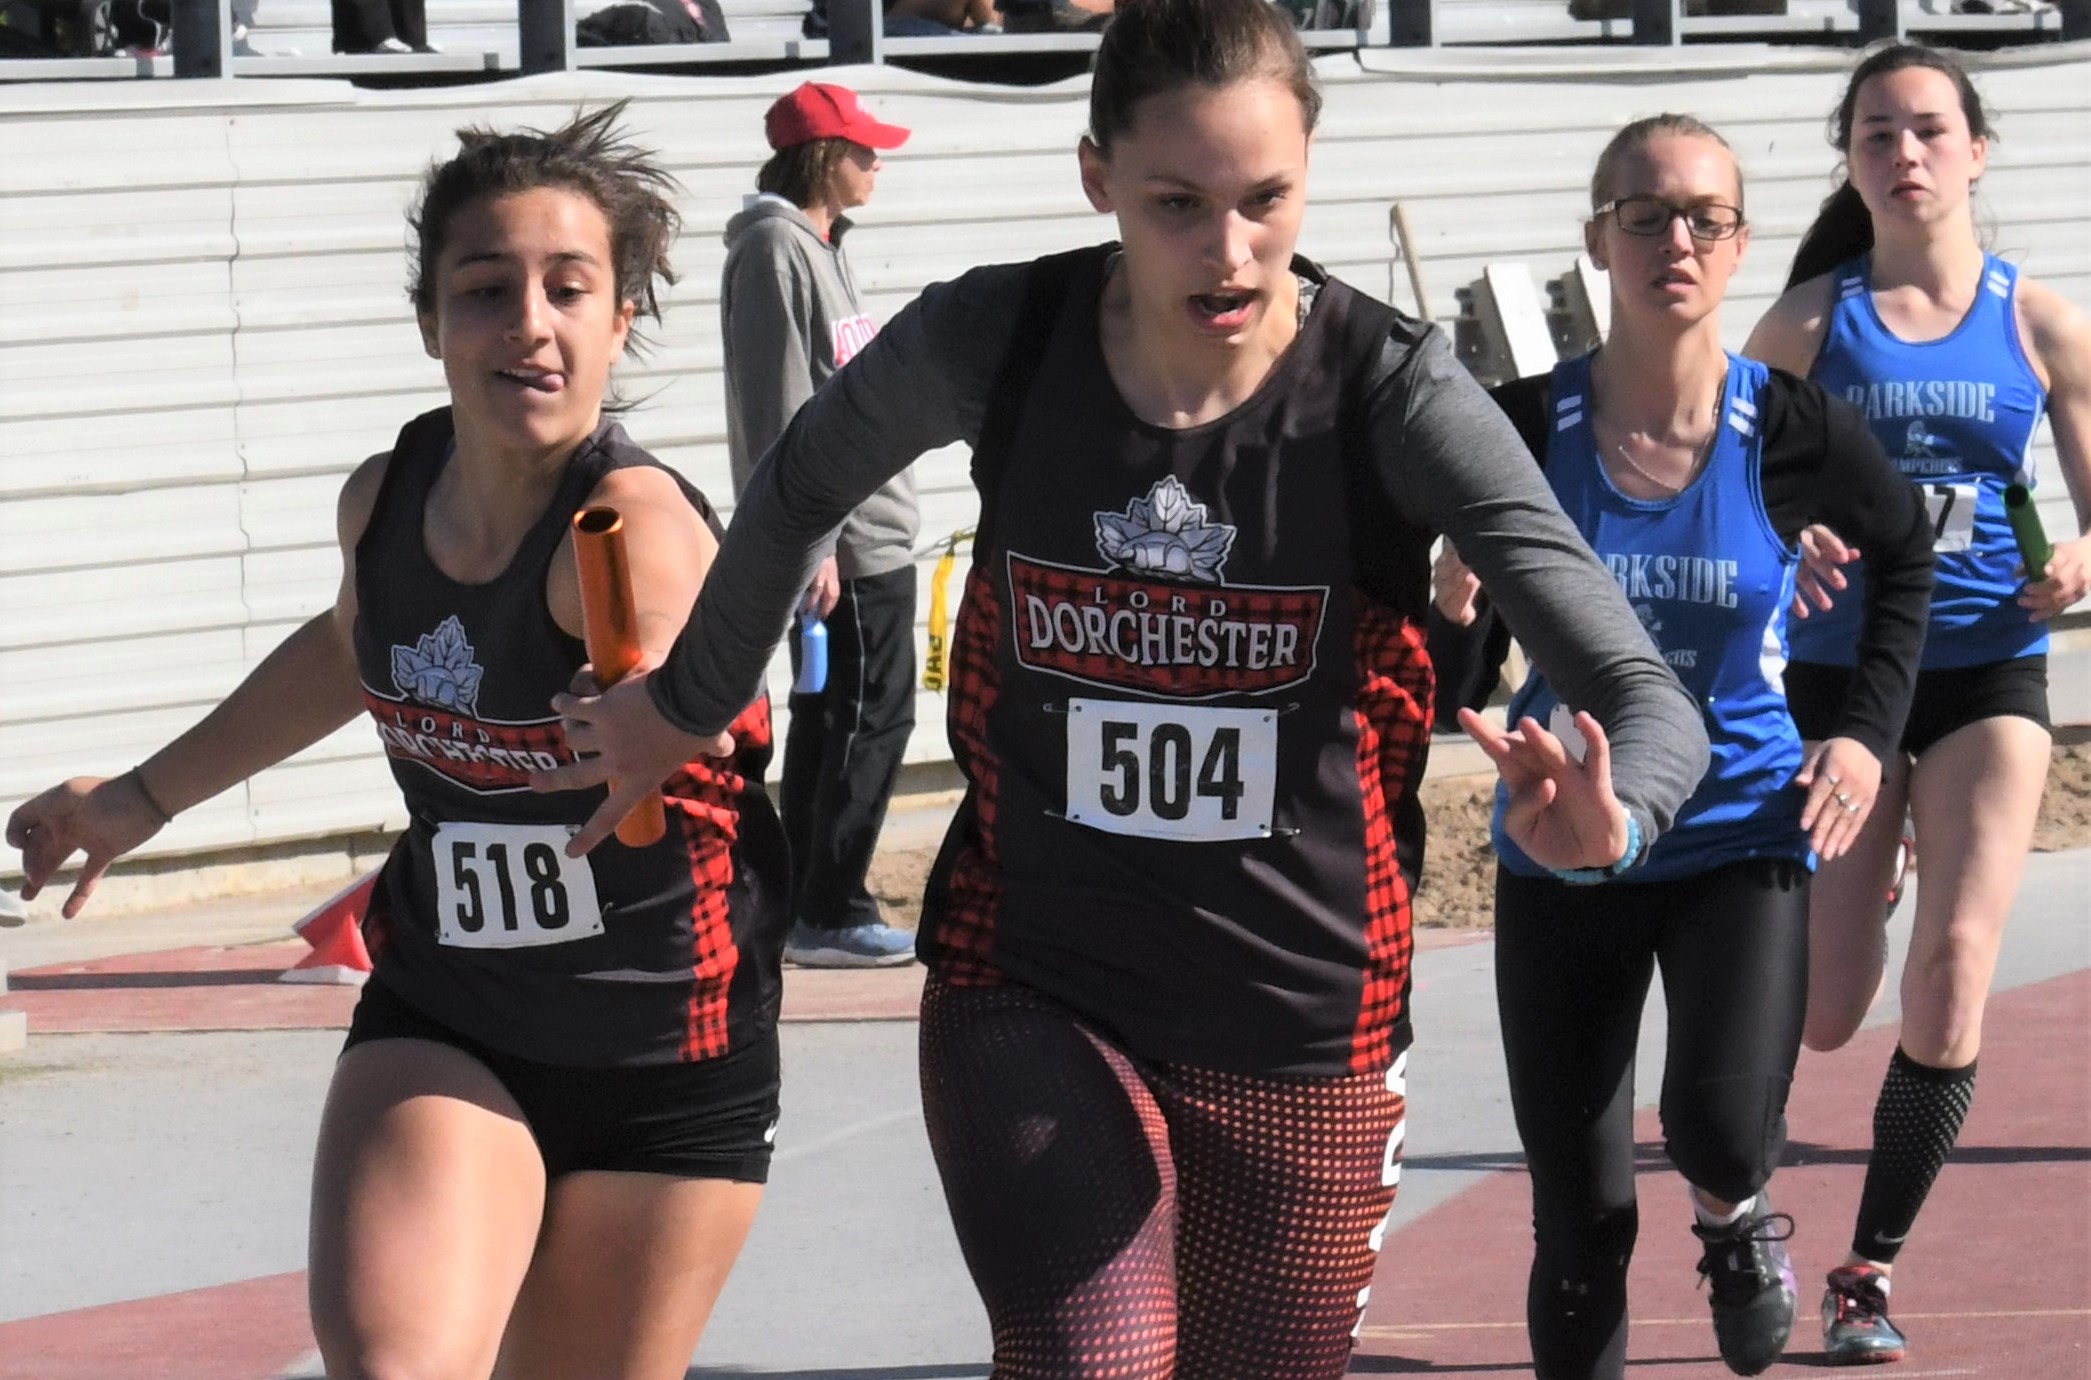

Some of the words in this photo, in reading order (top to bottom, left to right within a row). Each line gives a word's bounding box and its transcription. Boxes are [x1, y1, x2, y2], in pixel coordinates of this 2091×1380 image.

[1095, 586, 1227, 618] LORD
[1606, 553, 1738, 609] RKSIDE
[1026, 594, 1298, 671] DORCHESTER
[396, 711, 490, 743] LORD
[1100, 720, 1245, 821] 504
[452, 841, 570, 933] 518
